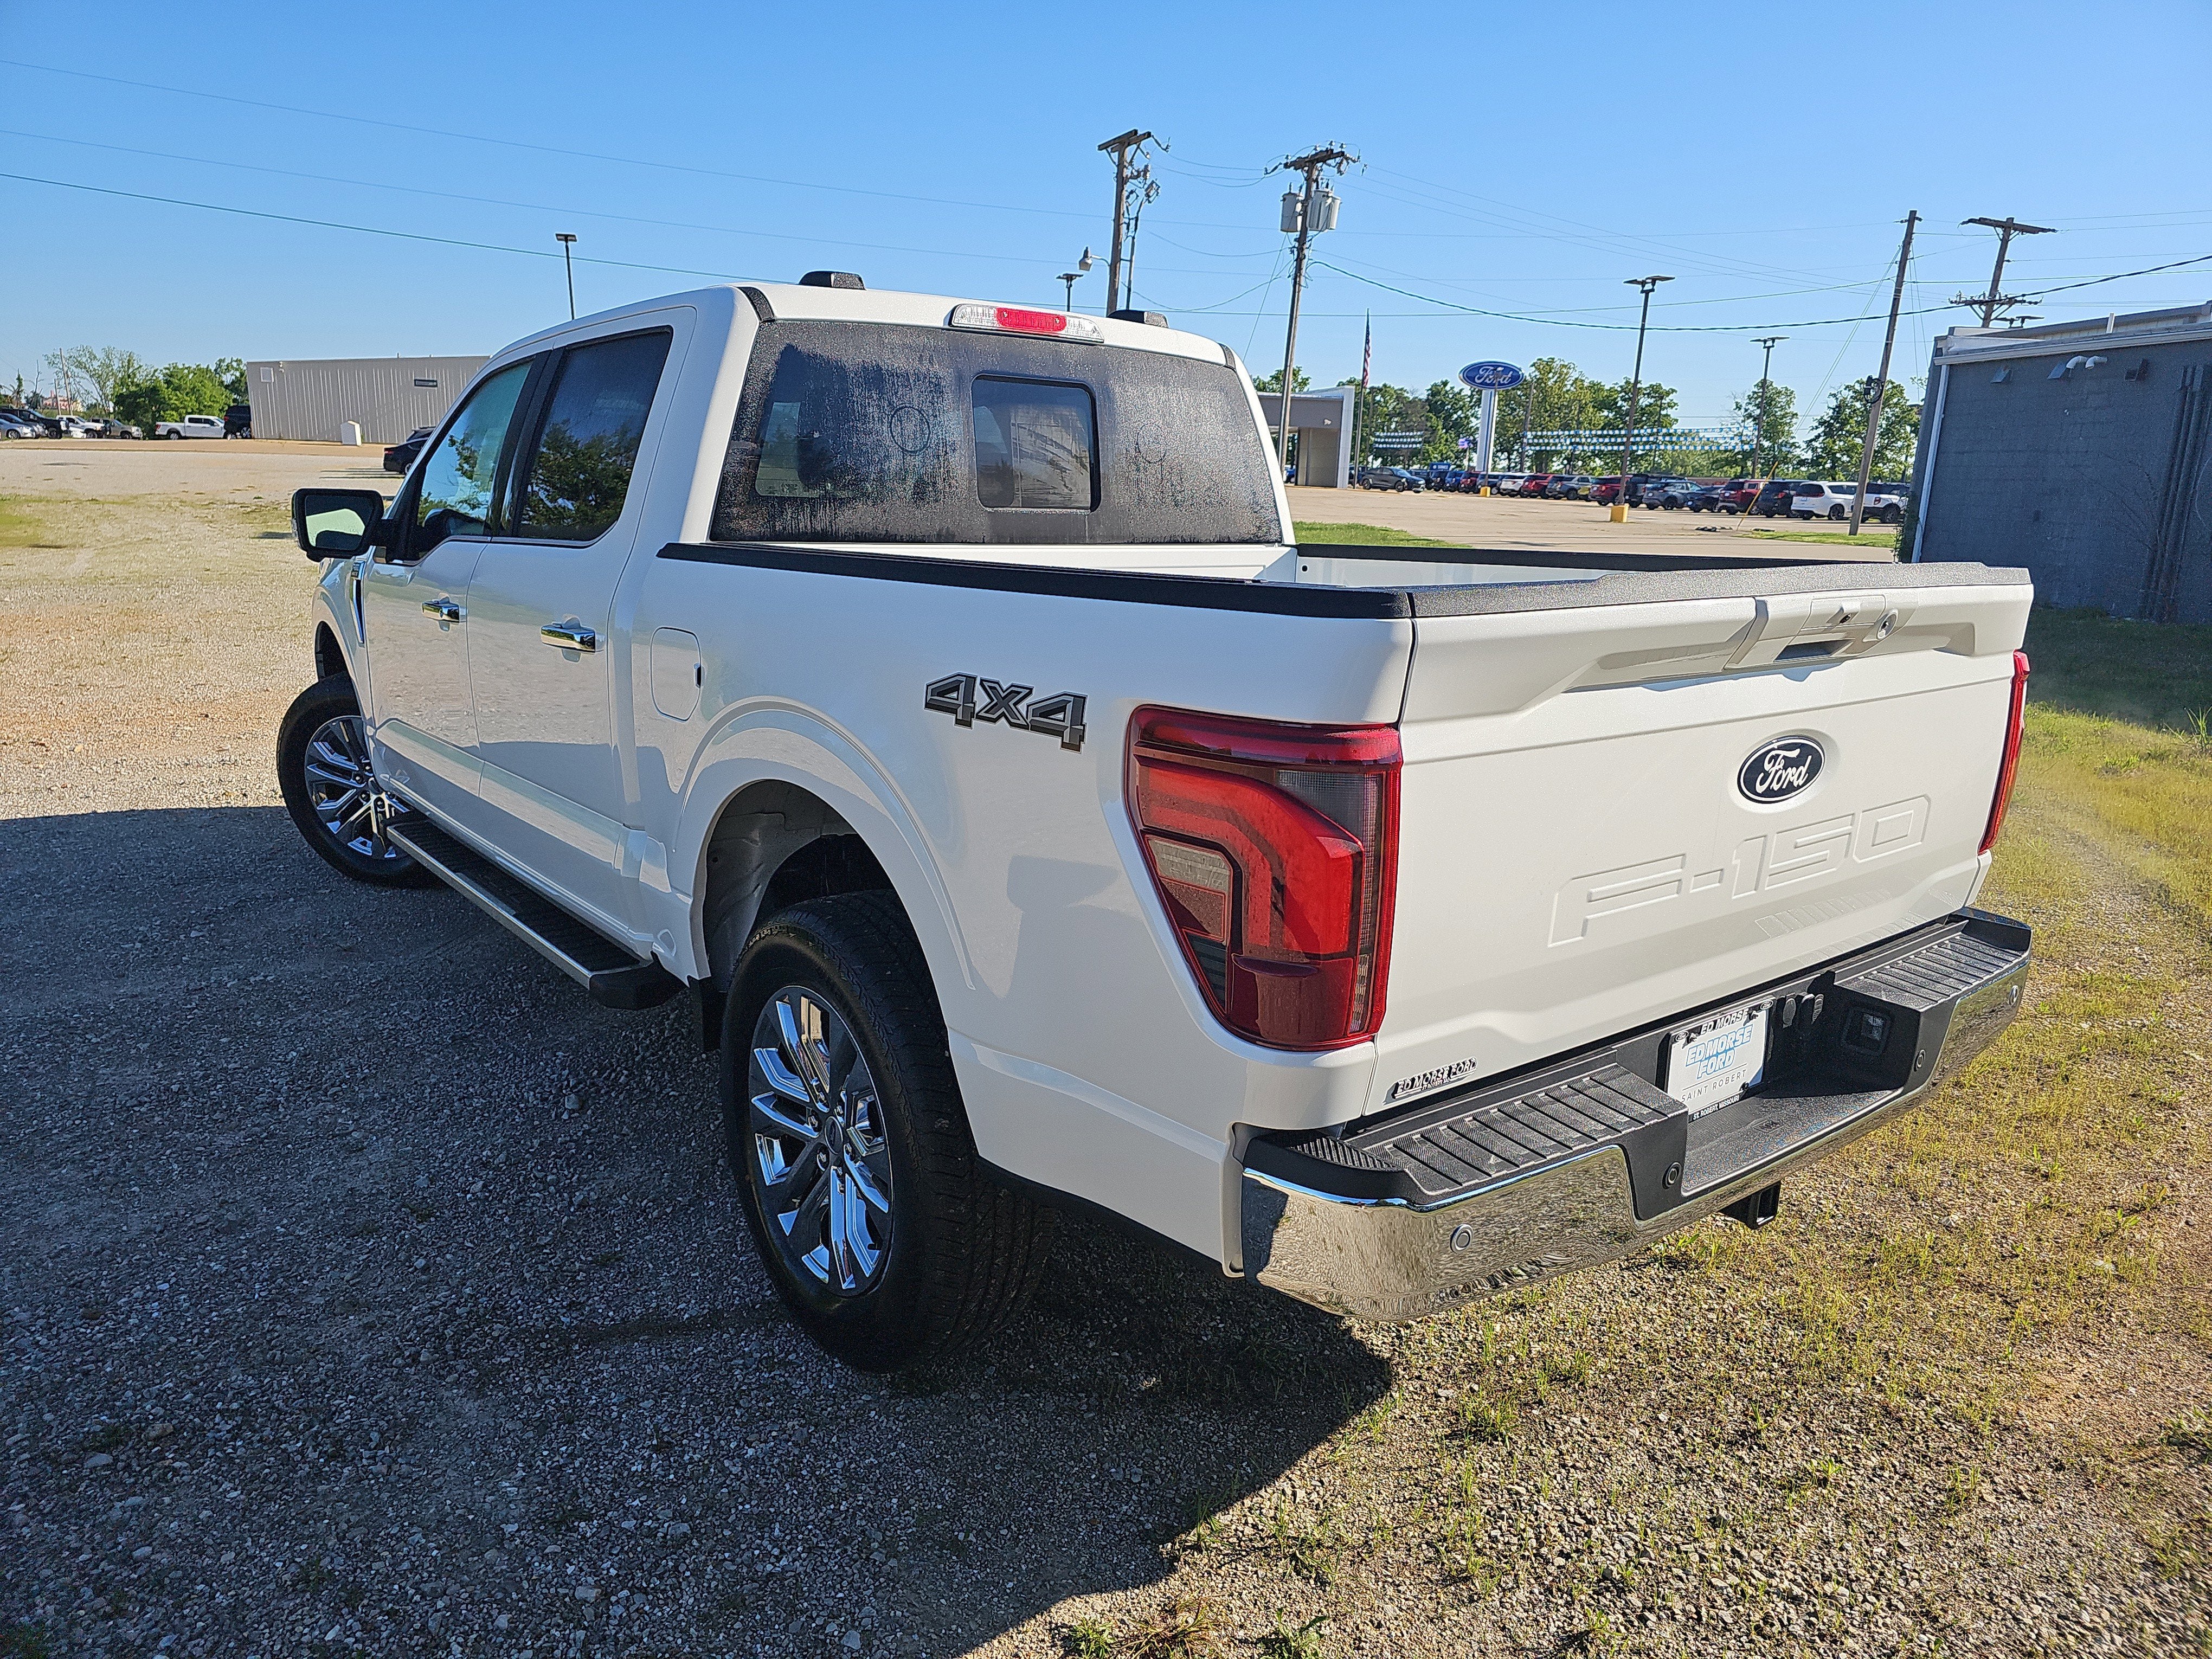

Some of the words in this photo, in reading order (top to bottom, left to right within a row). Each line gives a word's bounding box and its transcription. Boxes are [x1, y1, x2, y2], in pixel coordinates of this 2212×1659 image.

[1475, 366, 1513, 384] Ford
[1756, 748, 1812, 794] Ford
[1547, 793, 1932, 947] F-150
[1700, 1023, 1714, 1035] ED
[1715, 1008, 1750, 1030] MORSE
[1686, 1043, 1706, 1067] ED
[1706, 1024, 1753, 1058] MORSE
[1397, 1078, 1412, 1094] ED
[1413, 1066, 1450, 1089] MORSE
[1450, 1059, 1477, 1078] FORD
[1697, 1050, 1736, 1079] FORD
[1681, 1085, 1708, 1102] SAINT
[1712, 1069, 1746, 1090] ROBERT
[1719, 1095, 1740, 1109] MISSOURI
